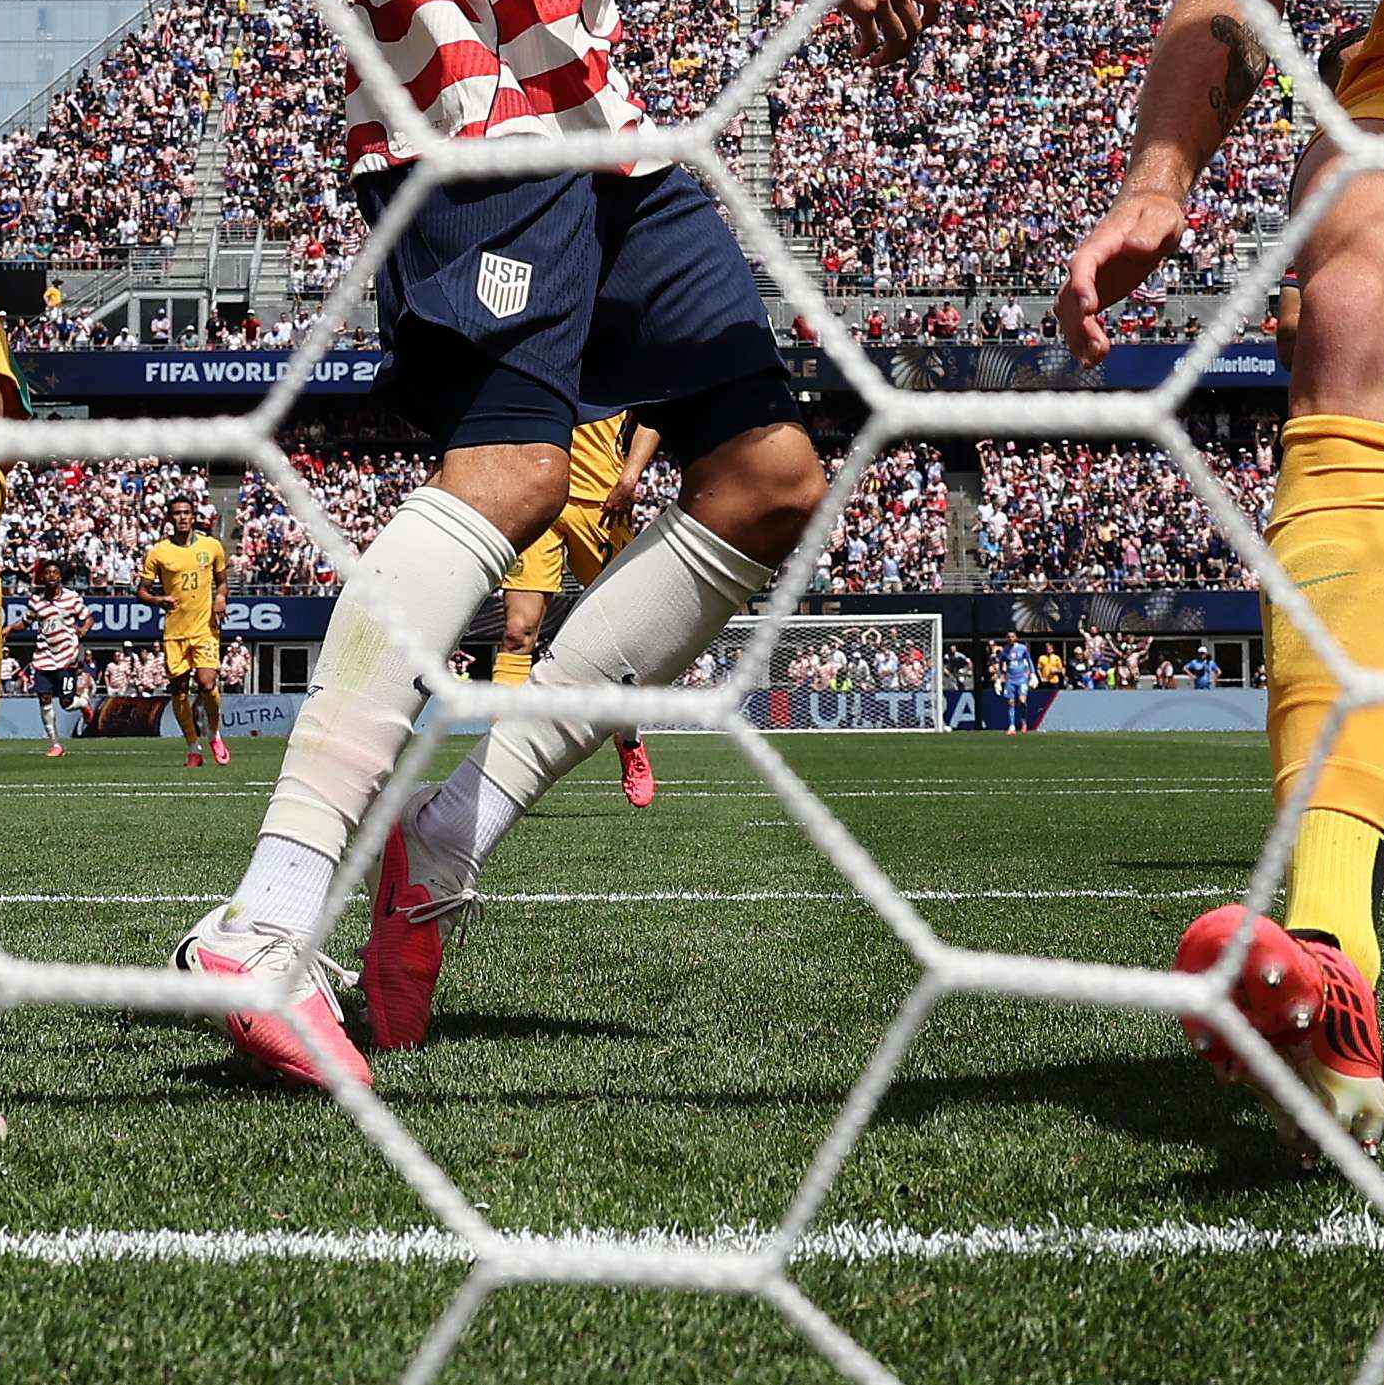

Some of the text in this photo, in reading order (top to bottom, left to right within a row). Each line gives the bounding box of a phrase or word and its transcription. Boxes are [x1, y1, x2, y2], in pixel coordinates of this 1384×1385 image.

[485, 257, 528, 284] USA
[145, 362, 199, 382] FIFA
[181, 571, 199, 591] 23
[88, 603, 152, 631] CUP
[62, 677, 75, 691] 16
[222, 710, 286, 726] ULTRA
